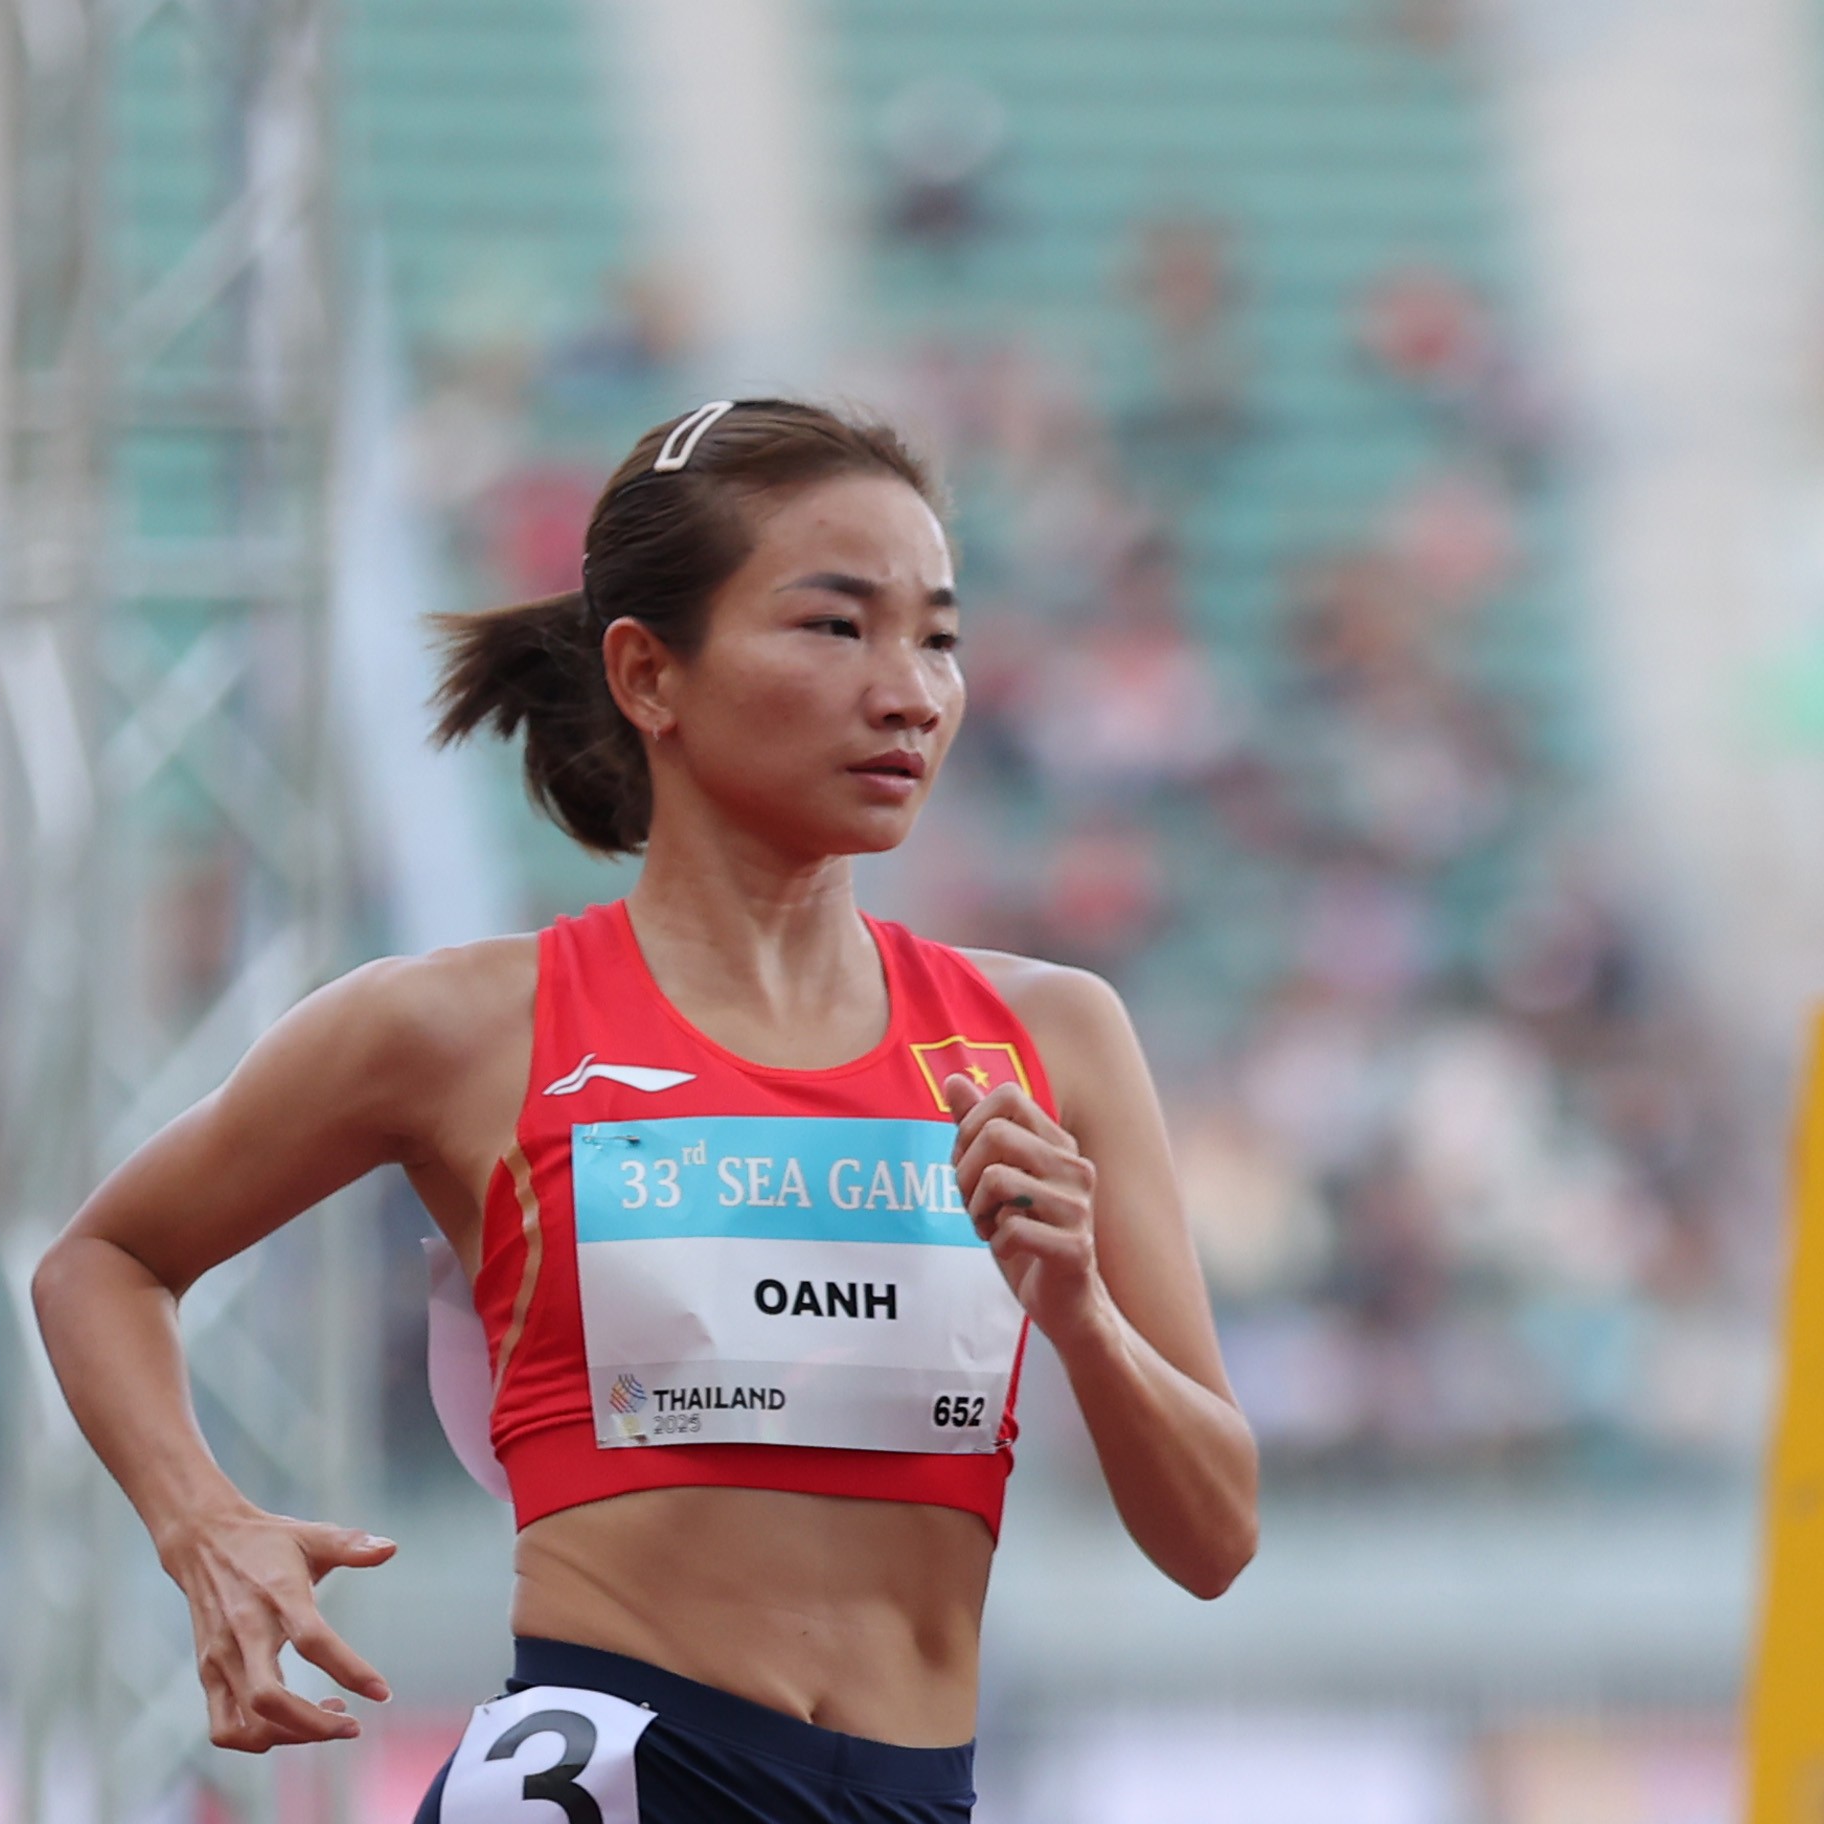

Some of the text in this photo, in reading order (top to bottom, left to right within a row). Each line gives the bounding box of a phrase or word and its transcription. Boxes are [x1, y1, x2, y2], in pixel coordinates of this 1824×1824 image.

[717, 1157, 812, 1208] SEA
[829, 1158, 969, 1214] GAME
[753, 1278, 898, 1320] OANH
[652, 1386, 786, 1412] THAILAND
[934, 1395, 985, 1428] 652
[653, 1413, 701, 1434] 2025
